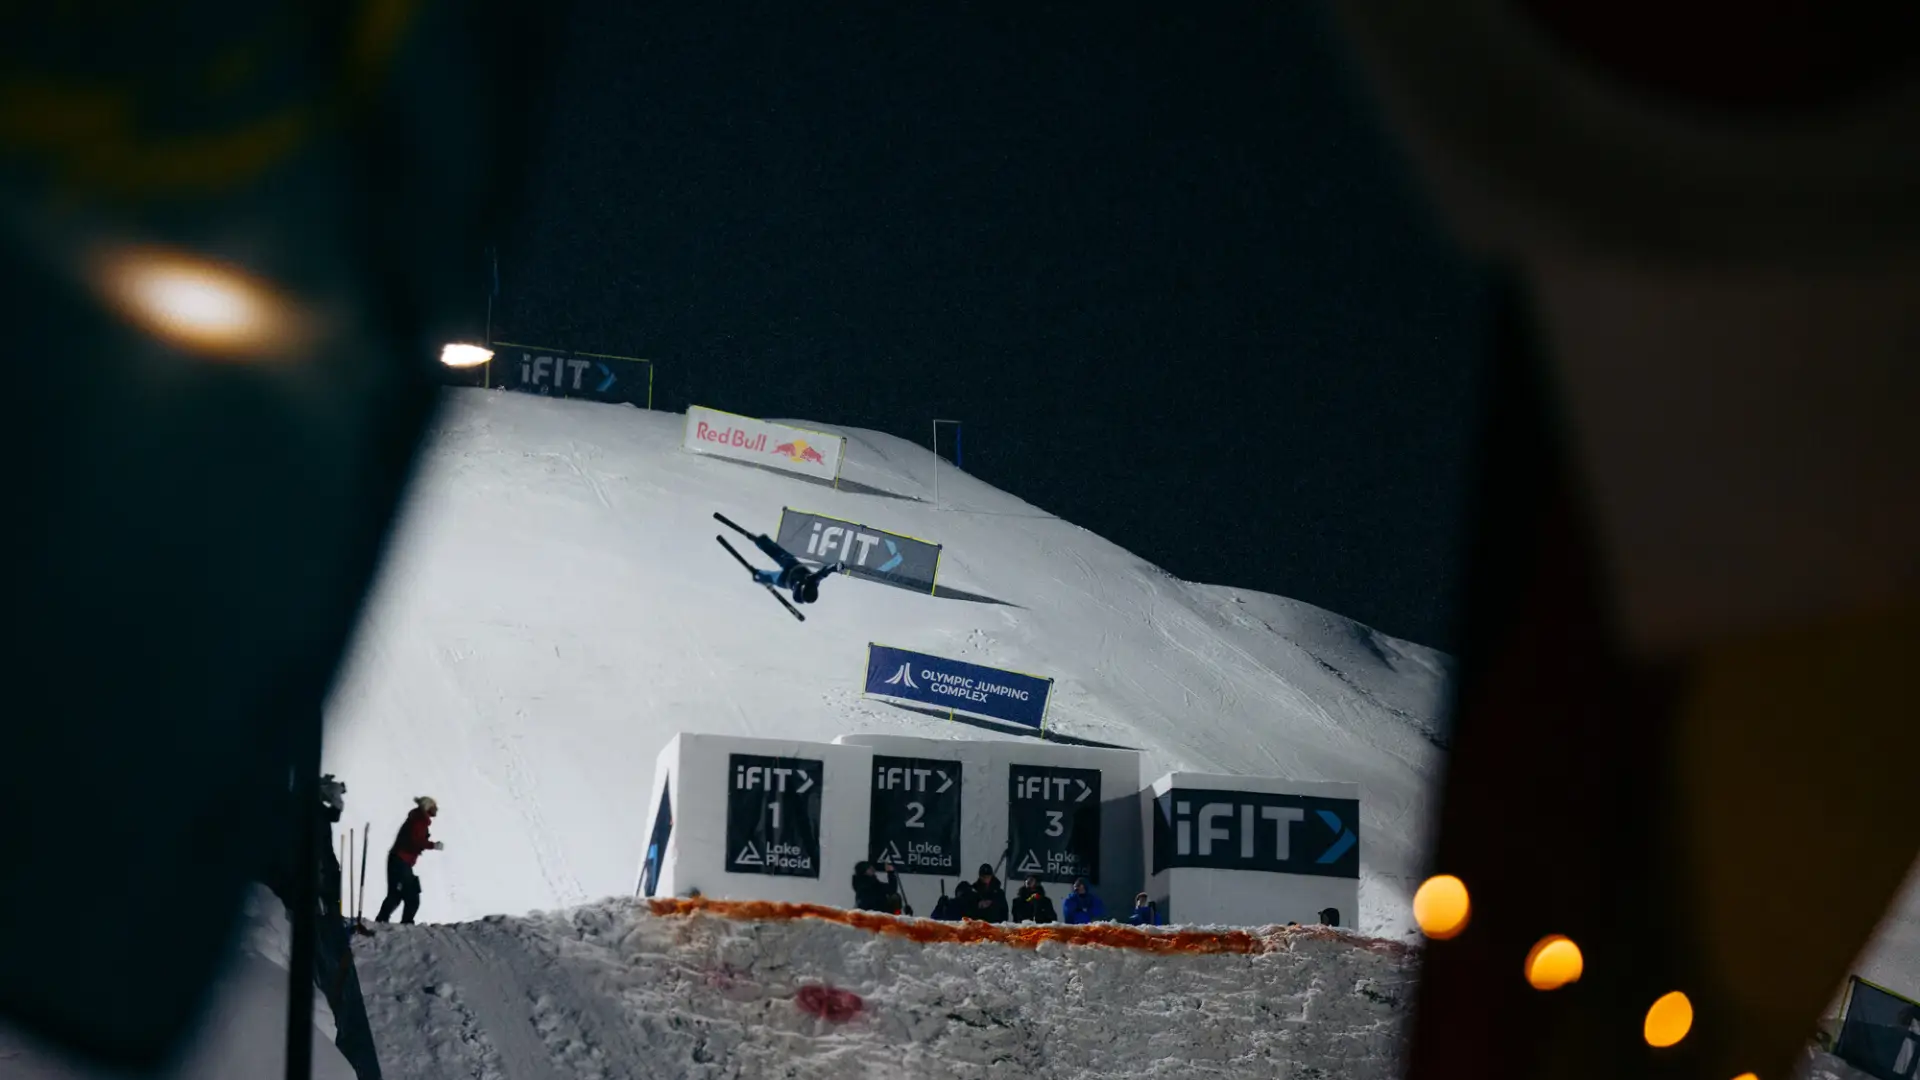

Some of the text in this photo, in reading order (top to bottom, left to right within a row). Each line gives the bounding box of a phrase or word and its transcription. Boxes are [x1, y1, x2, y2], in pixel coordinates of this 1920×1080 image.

[521, 353, 590, 389] iFIT
[806, 522, 880, 566] iFIT
[921, 669, 1029, 701] OLYMPIC JUMPING
[930, 683, 988, 703] COMPLEX
[736, 765, 793, 793] iFIT
[877, 766, 932, 792] iFIT
[1017, 775, 1071, 801] iFIT
[768, 802, 781, 829] 1
[904, 801, 925, 828] 2
[1044, 810, 1064, 837] 3
[1176, 801, 1305, 861] iFIT
[765, 841, 801, 855] Lake
[907, 841, 942, 854] Lake
[907, 853, 952, 867] Placid
[765, 854, 811, 870] Placid
